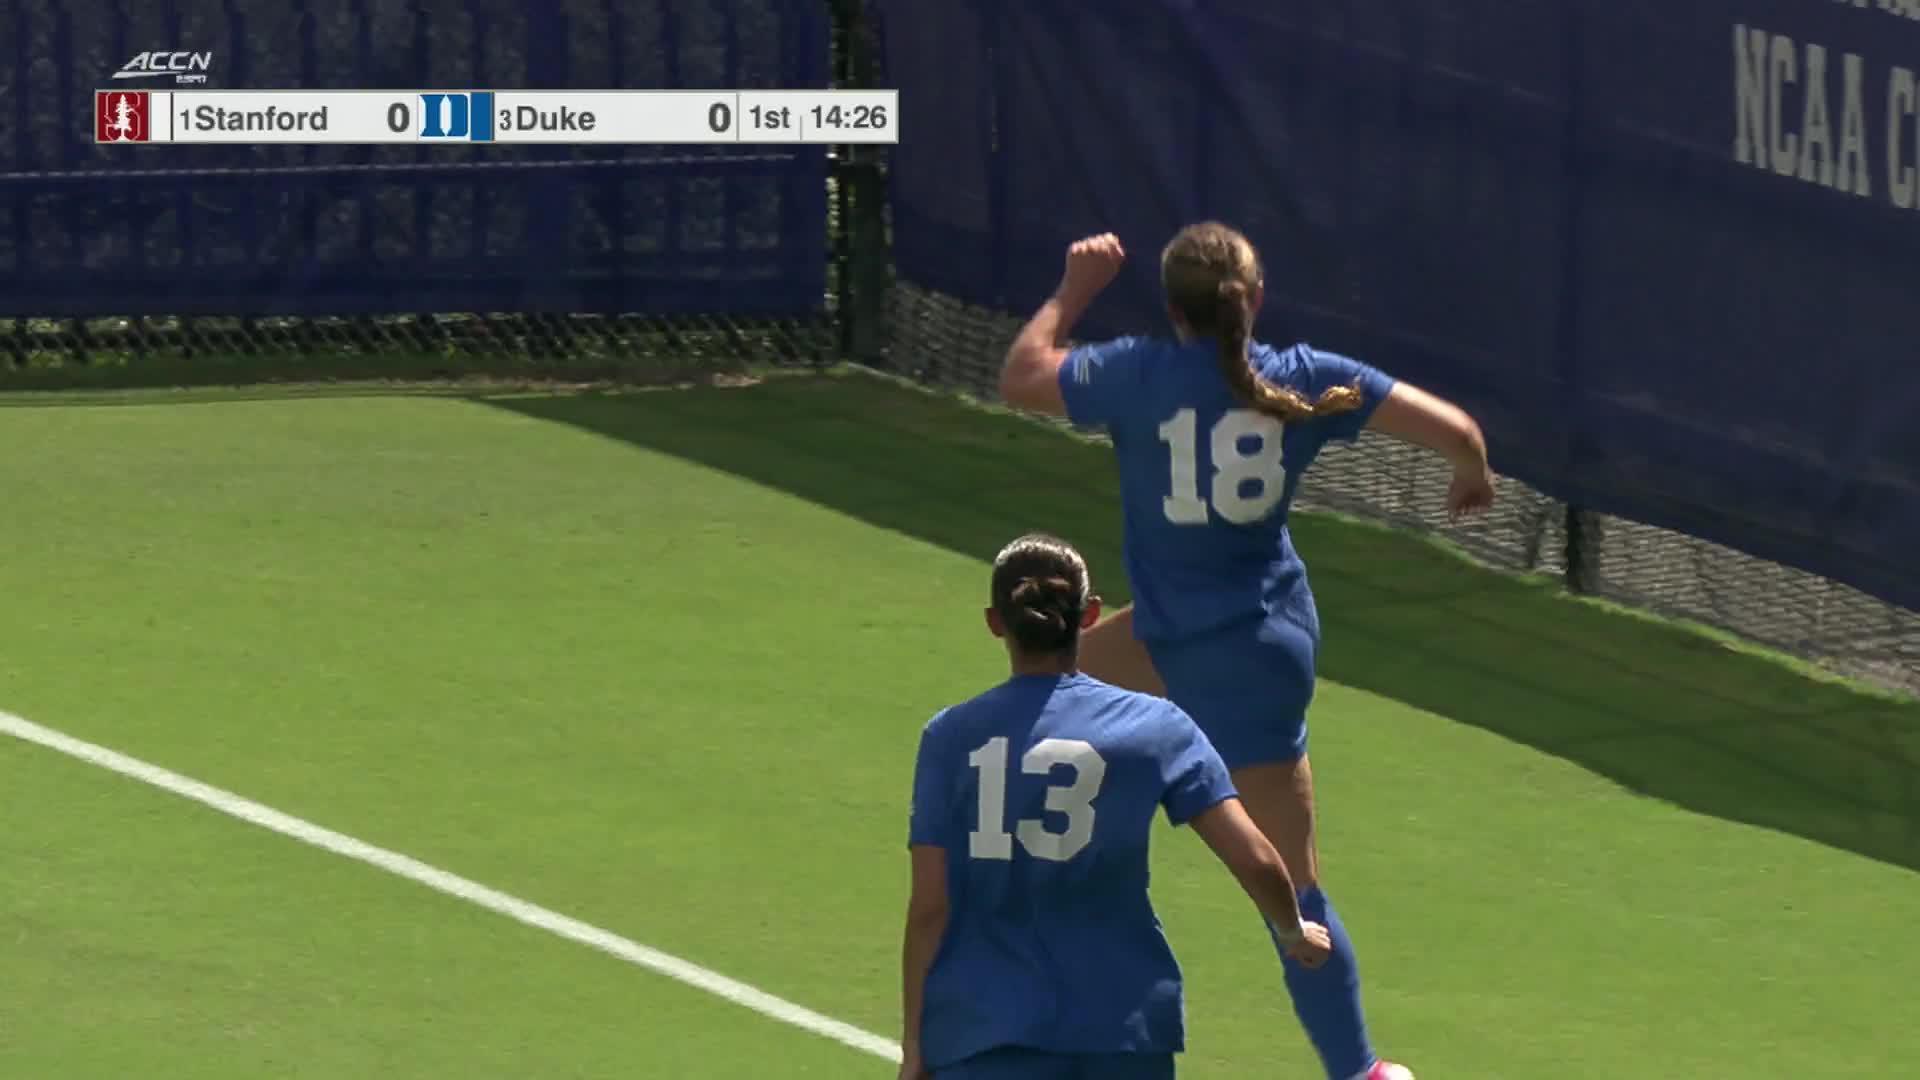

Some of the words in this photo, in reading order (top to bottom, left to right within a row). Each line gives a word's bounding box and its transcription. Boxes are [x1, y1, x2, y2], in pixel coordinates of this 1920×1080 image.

[1733, 23, 1871, 197] NCAA
[1888, 66, 1920, 211] C
[1158, 408, 1286, 525] 18
[969, 736, 1106, 862] 13
